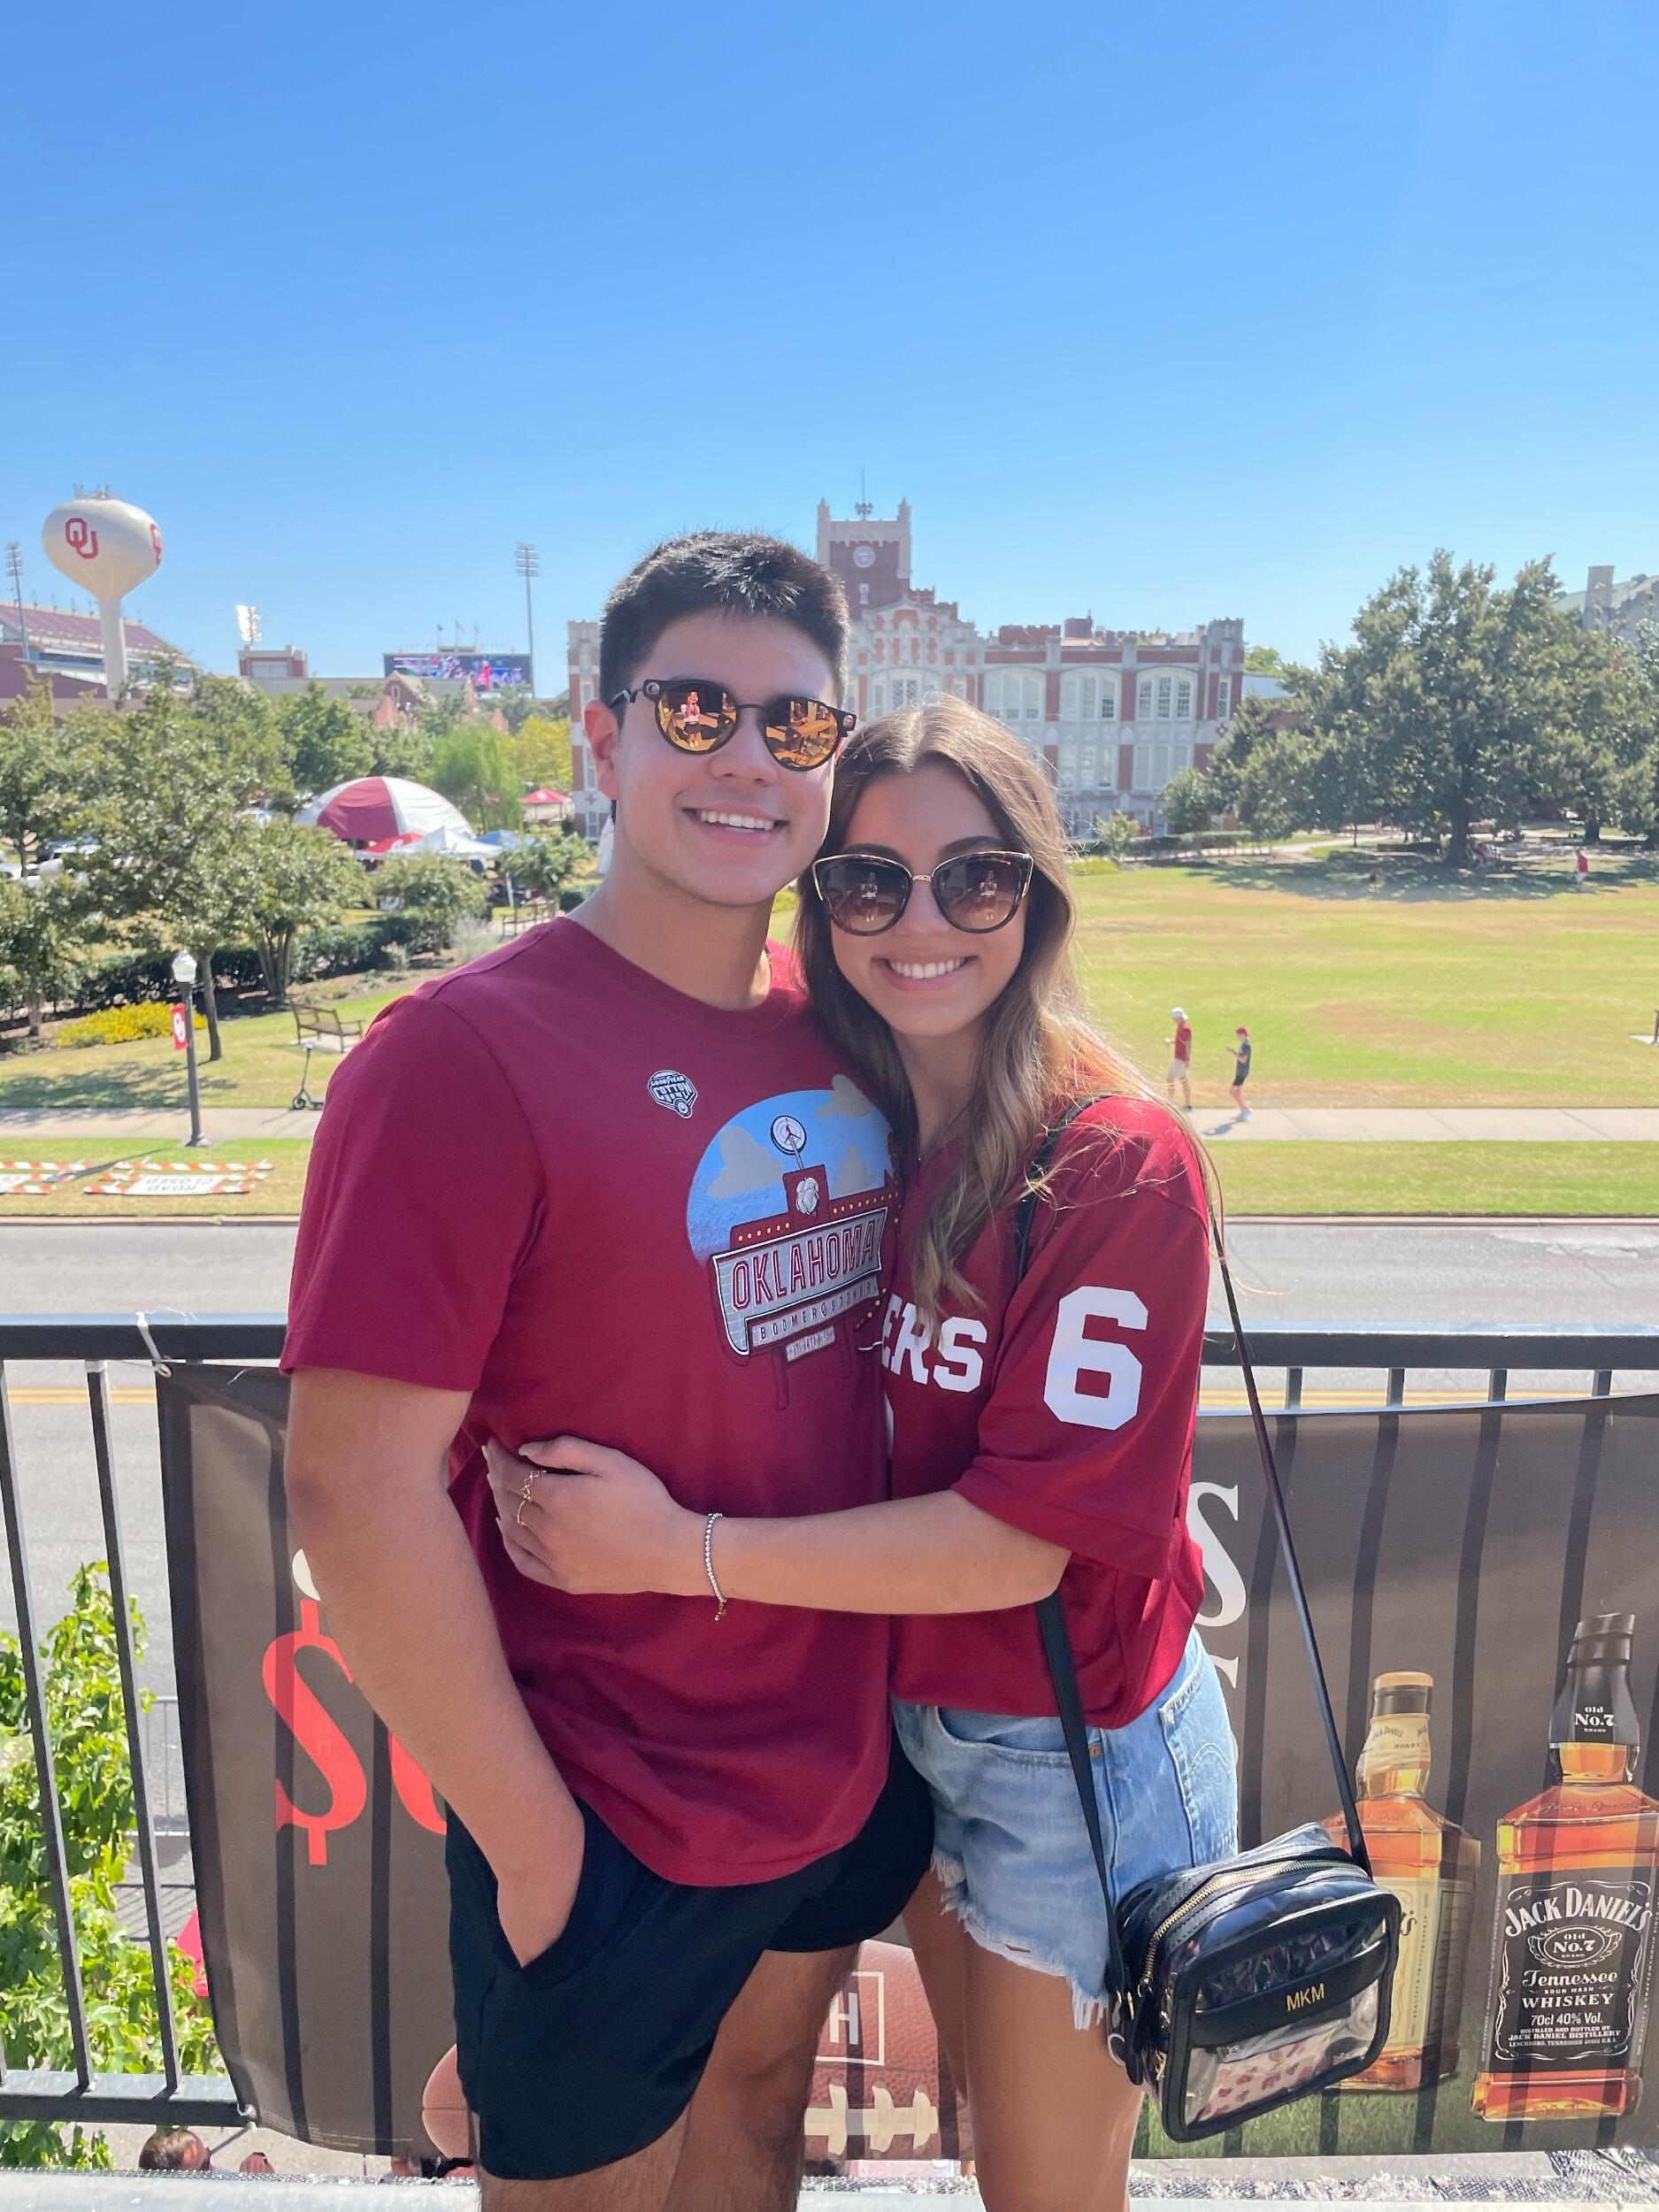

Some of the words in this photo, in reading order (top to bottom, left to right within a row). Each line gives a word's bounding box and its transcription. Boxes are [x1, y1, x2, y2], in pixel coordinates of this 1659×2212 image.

[65, 518, 99, 559] OU
[652, 1081, 695, 1101] COTTON
[731, 1219, 875, 1311] OKLAHOMA
[760, 1308, 818, 1340] BOOMER
[1043, 1286, 1148, 1431] 6
[1574, 1713, 1615, 1726] No.7
[1505, 1897, 1562, 1937] JACK
[1566, 1887, 1652, 1932] DANIEL'S
[1553, 1939, 1596, 1954] No.7
[1522, 1970, 1618, 1987] Tennessee
[1286, 1983, 1325, 2011] MKM
[1522, 1993, 1615, 2008] WHISKEY
[1531, 2014, 1554, 2026] 70cl
[1556, 2012, 1581, 2024] 40%
[1584, 2011, 1603, 2024] Vol.
[1569, 2030, 1622, 2039] DISTILLERY
